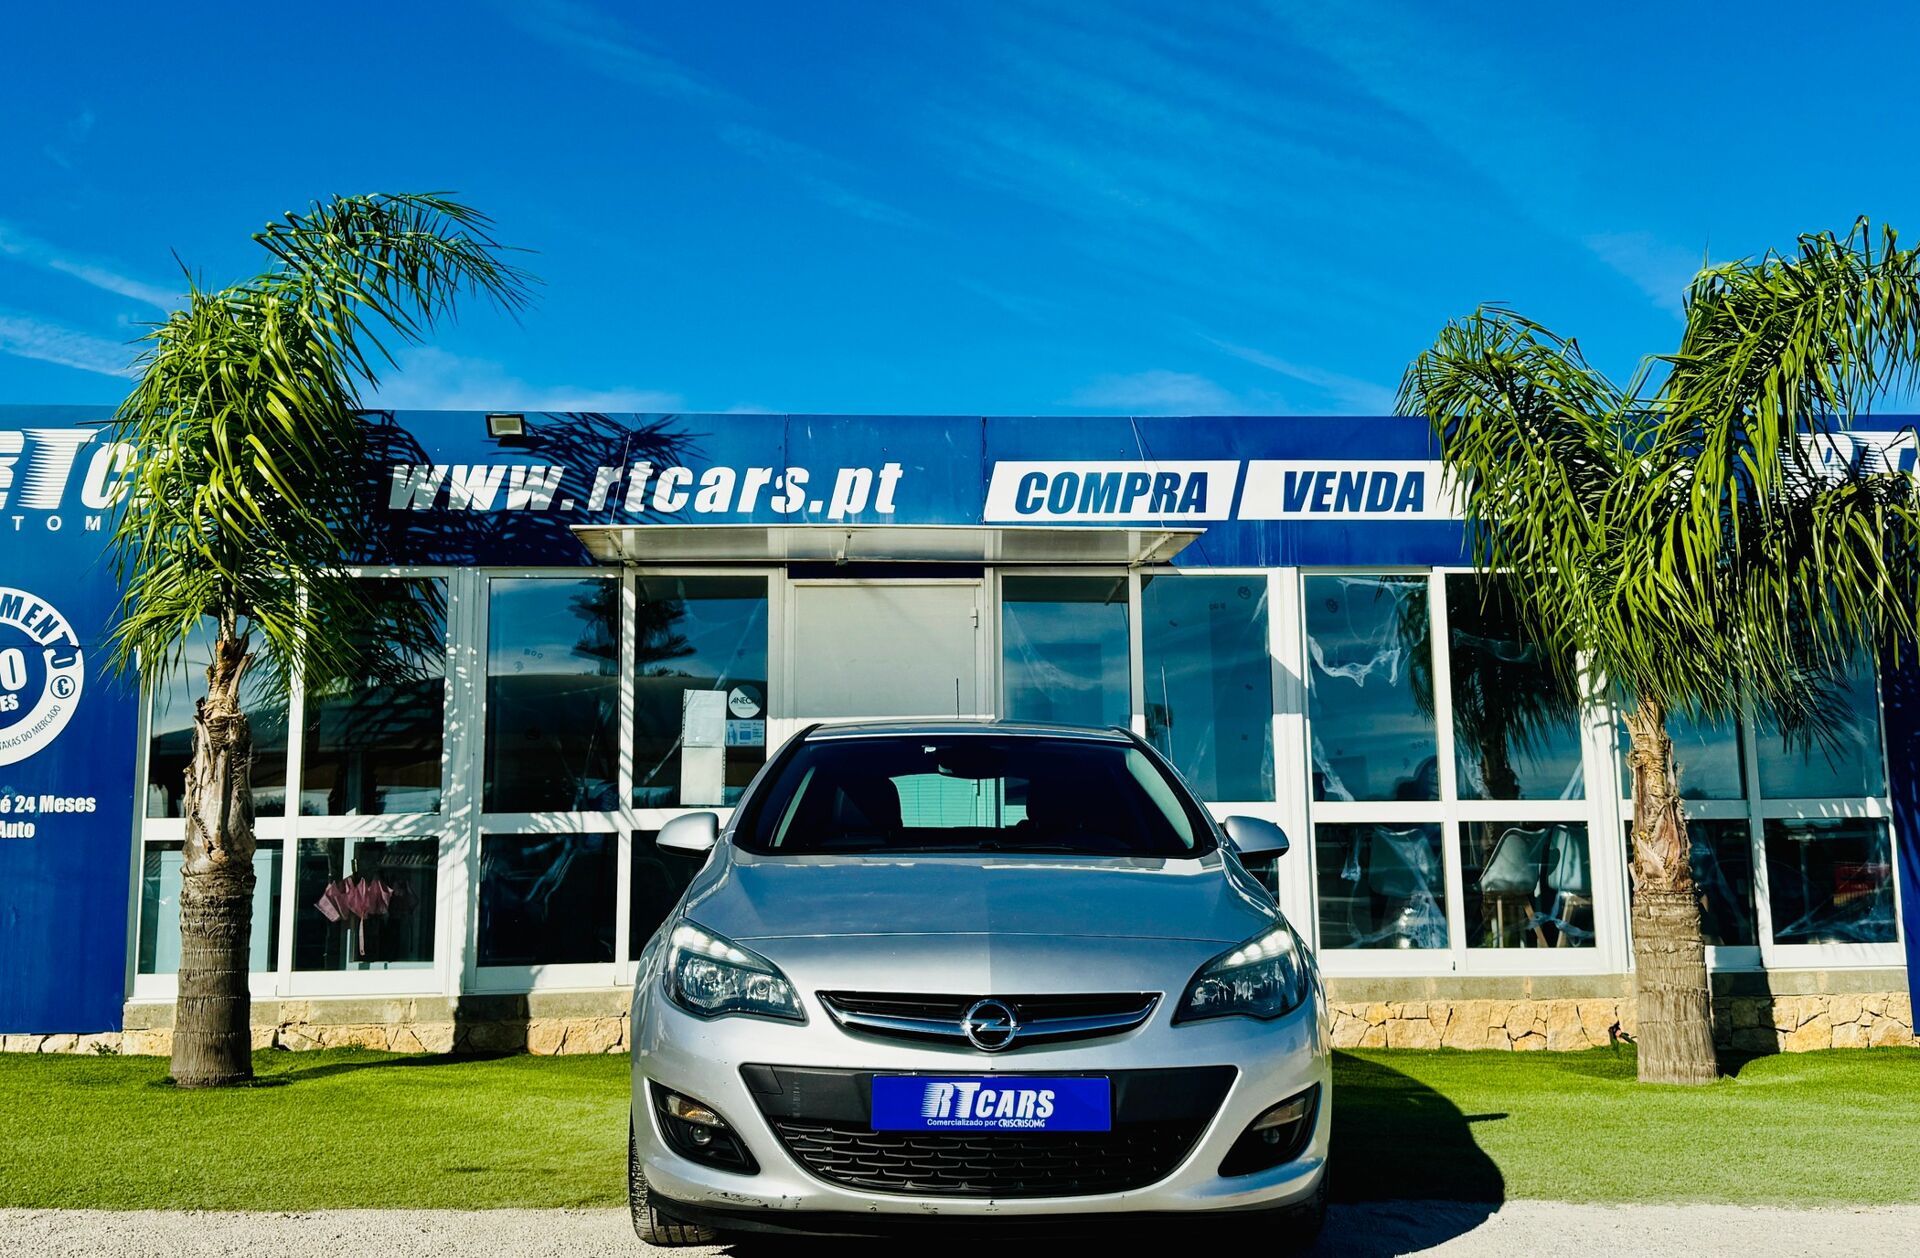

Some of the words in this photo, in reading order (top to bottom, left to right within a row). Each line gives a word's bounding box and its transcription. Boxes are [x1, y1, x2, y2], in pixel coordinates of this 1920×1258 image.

[388, 462, 903, 519] www.rtcars.pt
[1015, 472, 1208, 514] COMPRA
[1283, 471, 1424, 513] VENDA
[21, 731, 33, 742] DO
[32, 704, 61, 735] MERCADO
[14, 795, 36, 813] 24
[39, 795, 96, 813] Meses
[920, 1082, 1055, 1118] RTCARS
[927, 1119, 983, 1127] Comercializado
[984, 1120, 997, 1128] por
